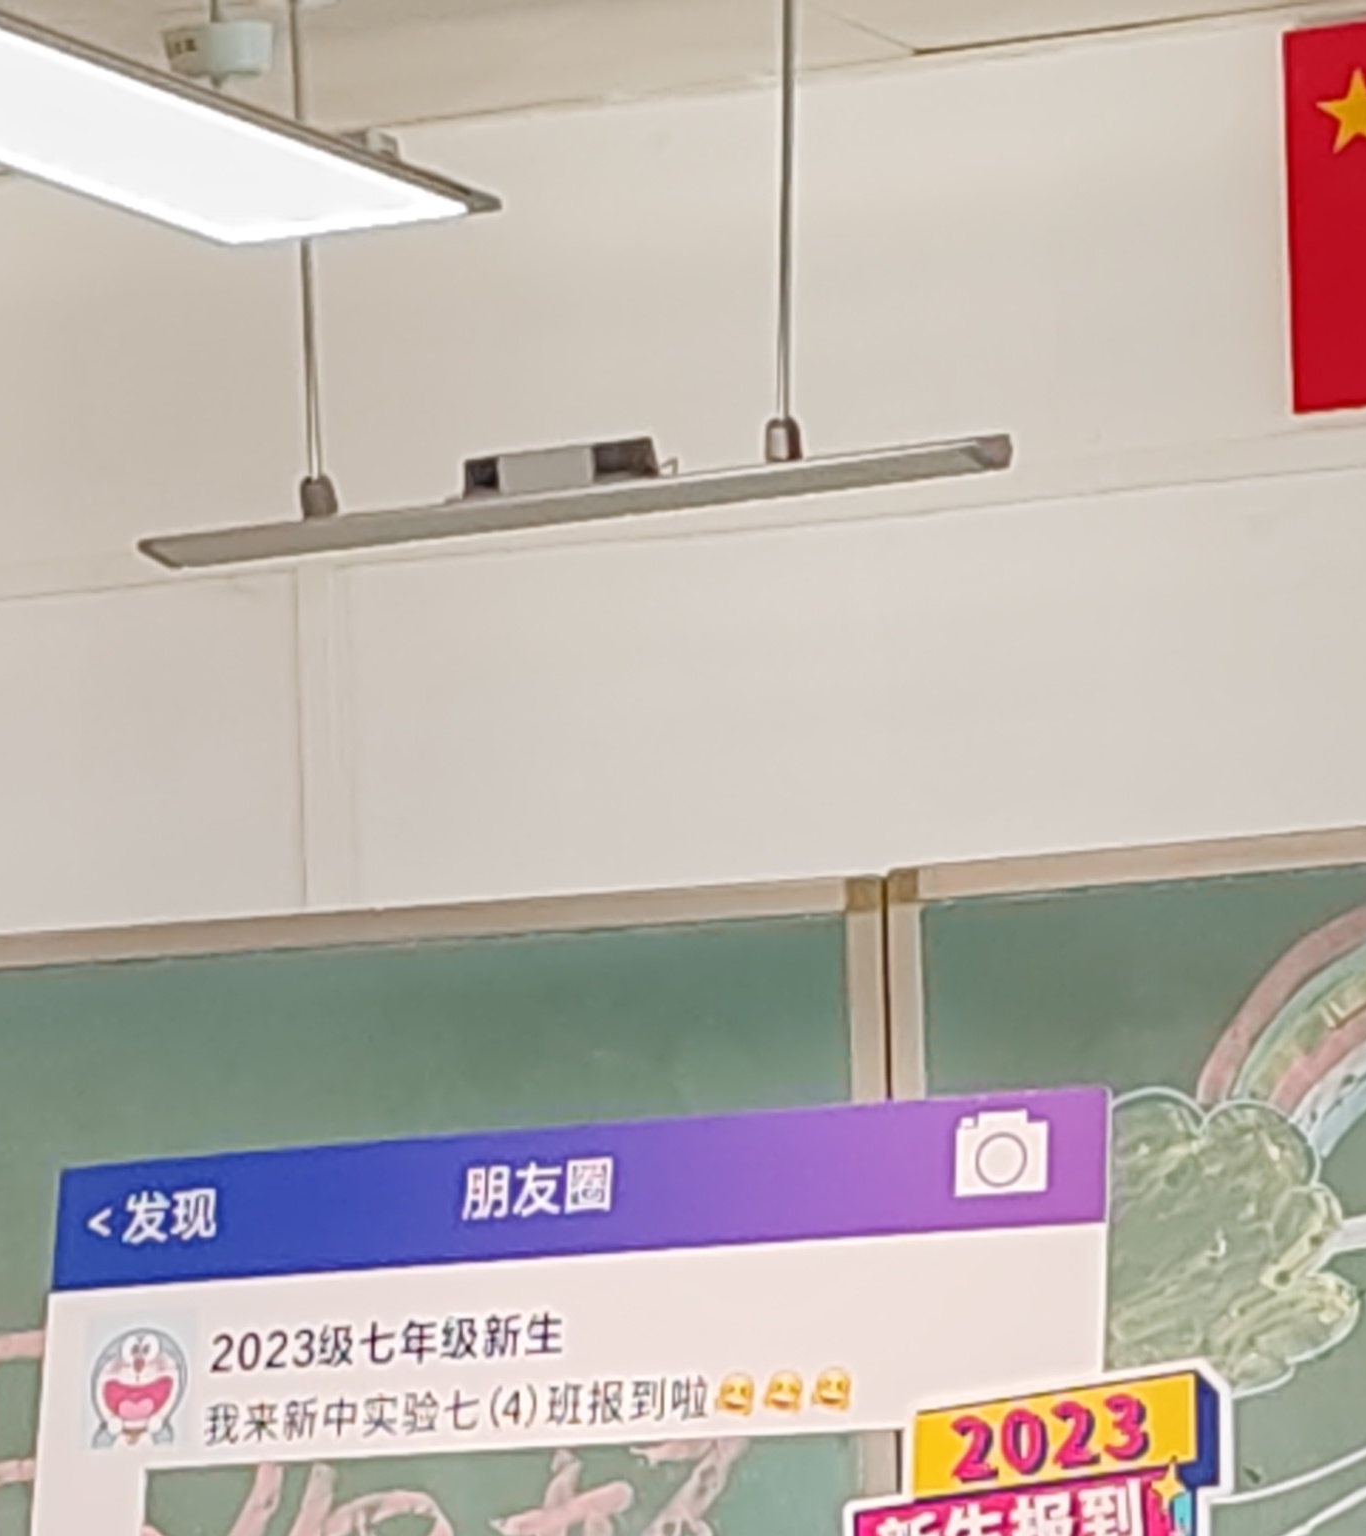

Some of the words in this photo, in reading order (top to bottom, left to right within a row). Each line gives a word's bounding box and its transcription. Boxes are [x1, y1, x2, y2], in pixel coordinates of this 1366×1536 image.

[122, 1187, 218, 1245] 发现
[461, 1155, 615, 1221] 朋友圈
[209, 1311, 565, 1374] 2023级七年级新生
[950, 1392, 1153, 1486] 2023
